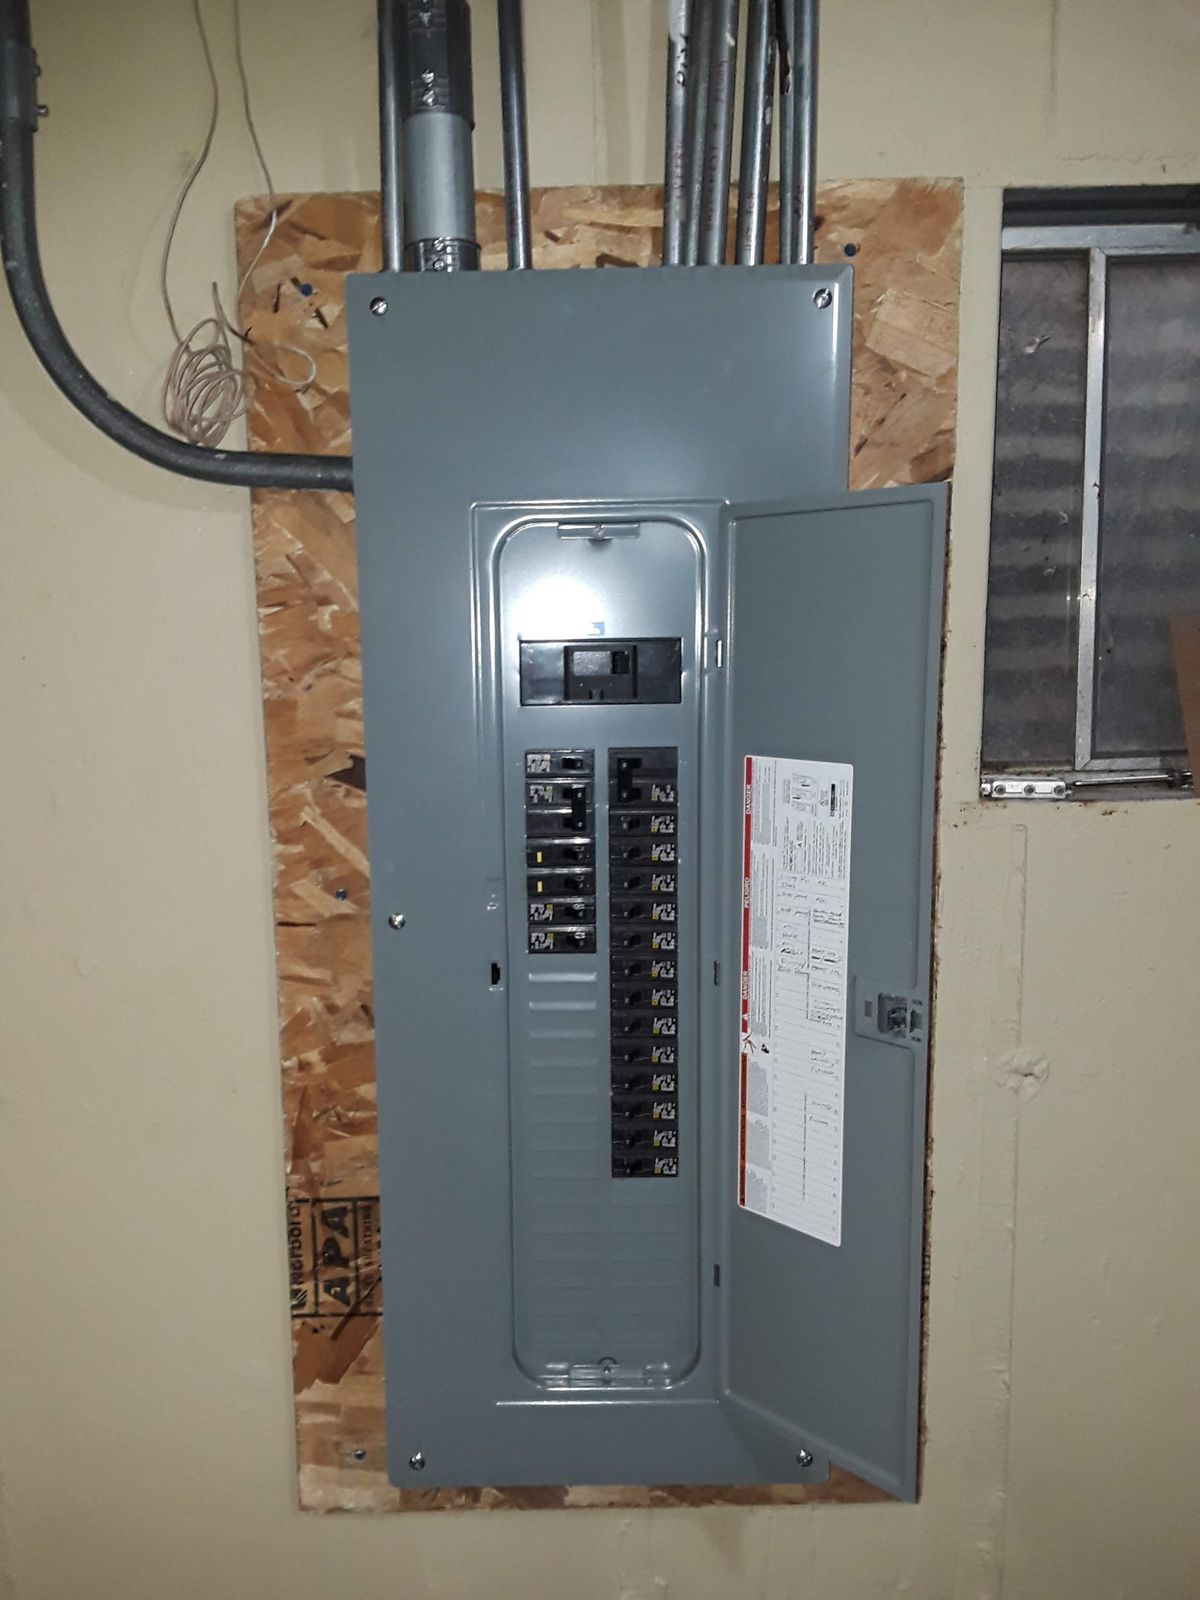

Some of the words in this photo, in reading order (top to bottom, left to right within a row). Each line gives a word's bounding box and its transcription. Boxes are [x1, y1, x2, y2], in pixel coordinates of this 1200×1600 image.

[743, 877, 751, 909] PELIGRO
[742, 970, 750, 1000] DANGER
[321, 1206, 352, 1307] APA
